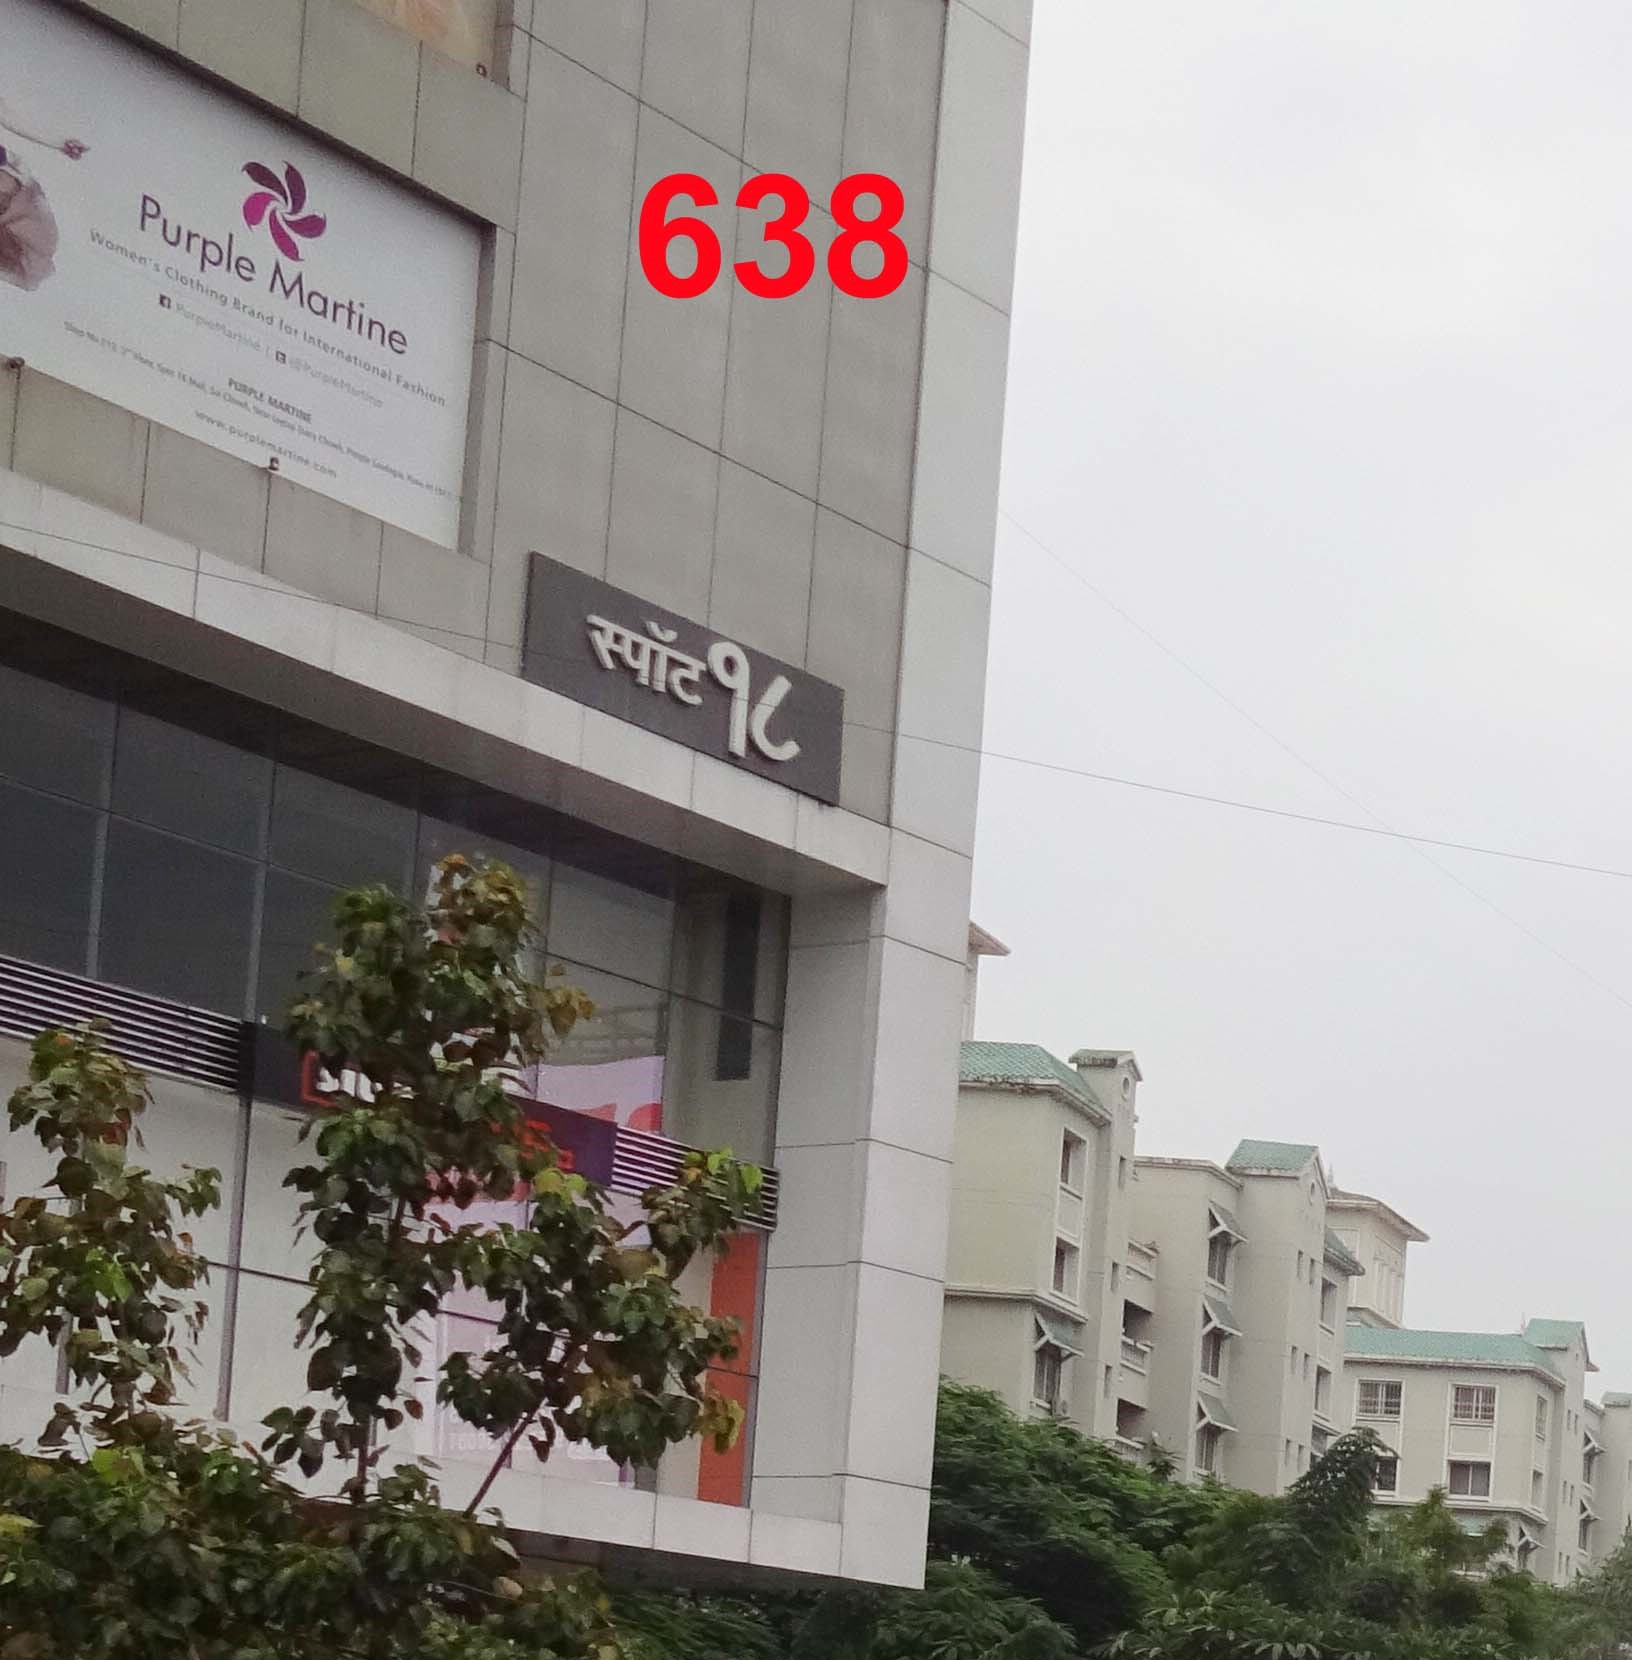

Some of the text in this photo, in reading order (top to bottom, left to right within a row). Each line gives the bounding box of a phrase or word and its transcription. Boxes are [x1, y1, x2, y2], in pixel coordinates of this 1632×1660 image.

[139, 193, 409, 355] Purple Martine
[165, 266, 228, 307] Clothing
[232, 297, 275, 326] Brand
[278, 314, 299, 335] for
[302, 329, 392, 383] International
[395, 373, 447, 407] Fashion
[586, 613, 710, 706] स्पॉट
